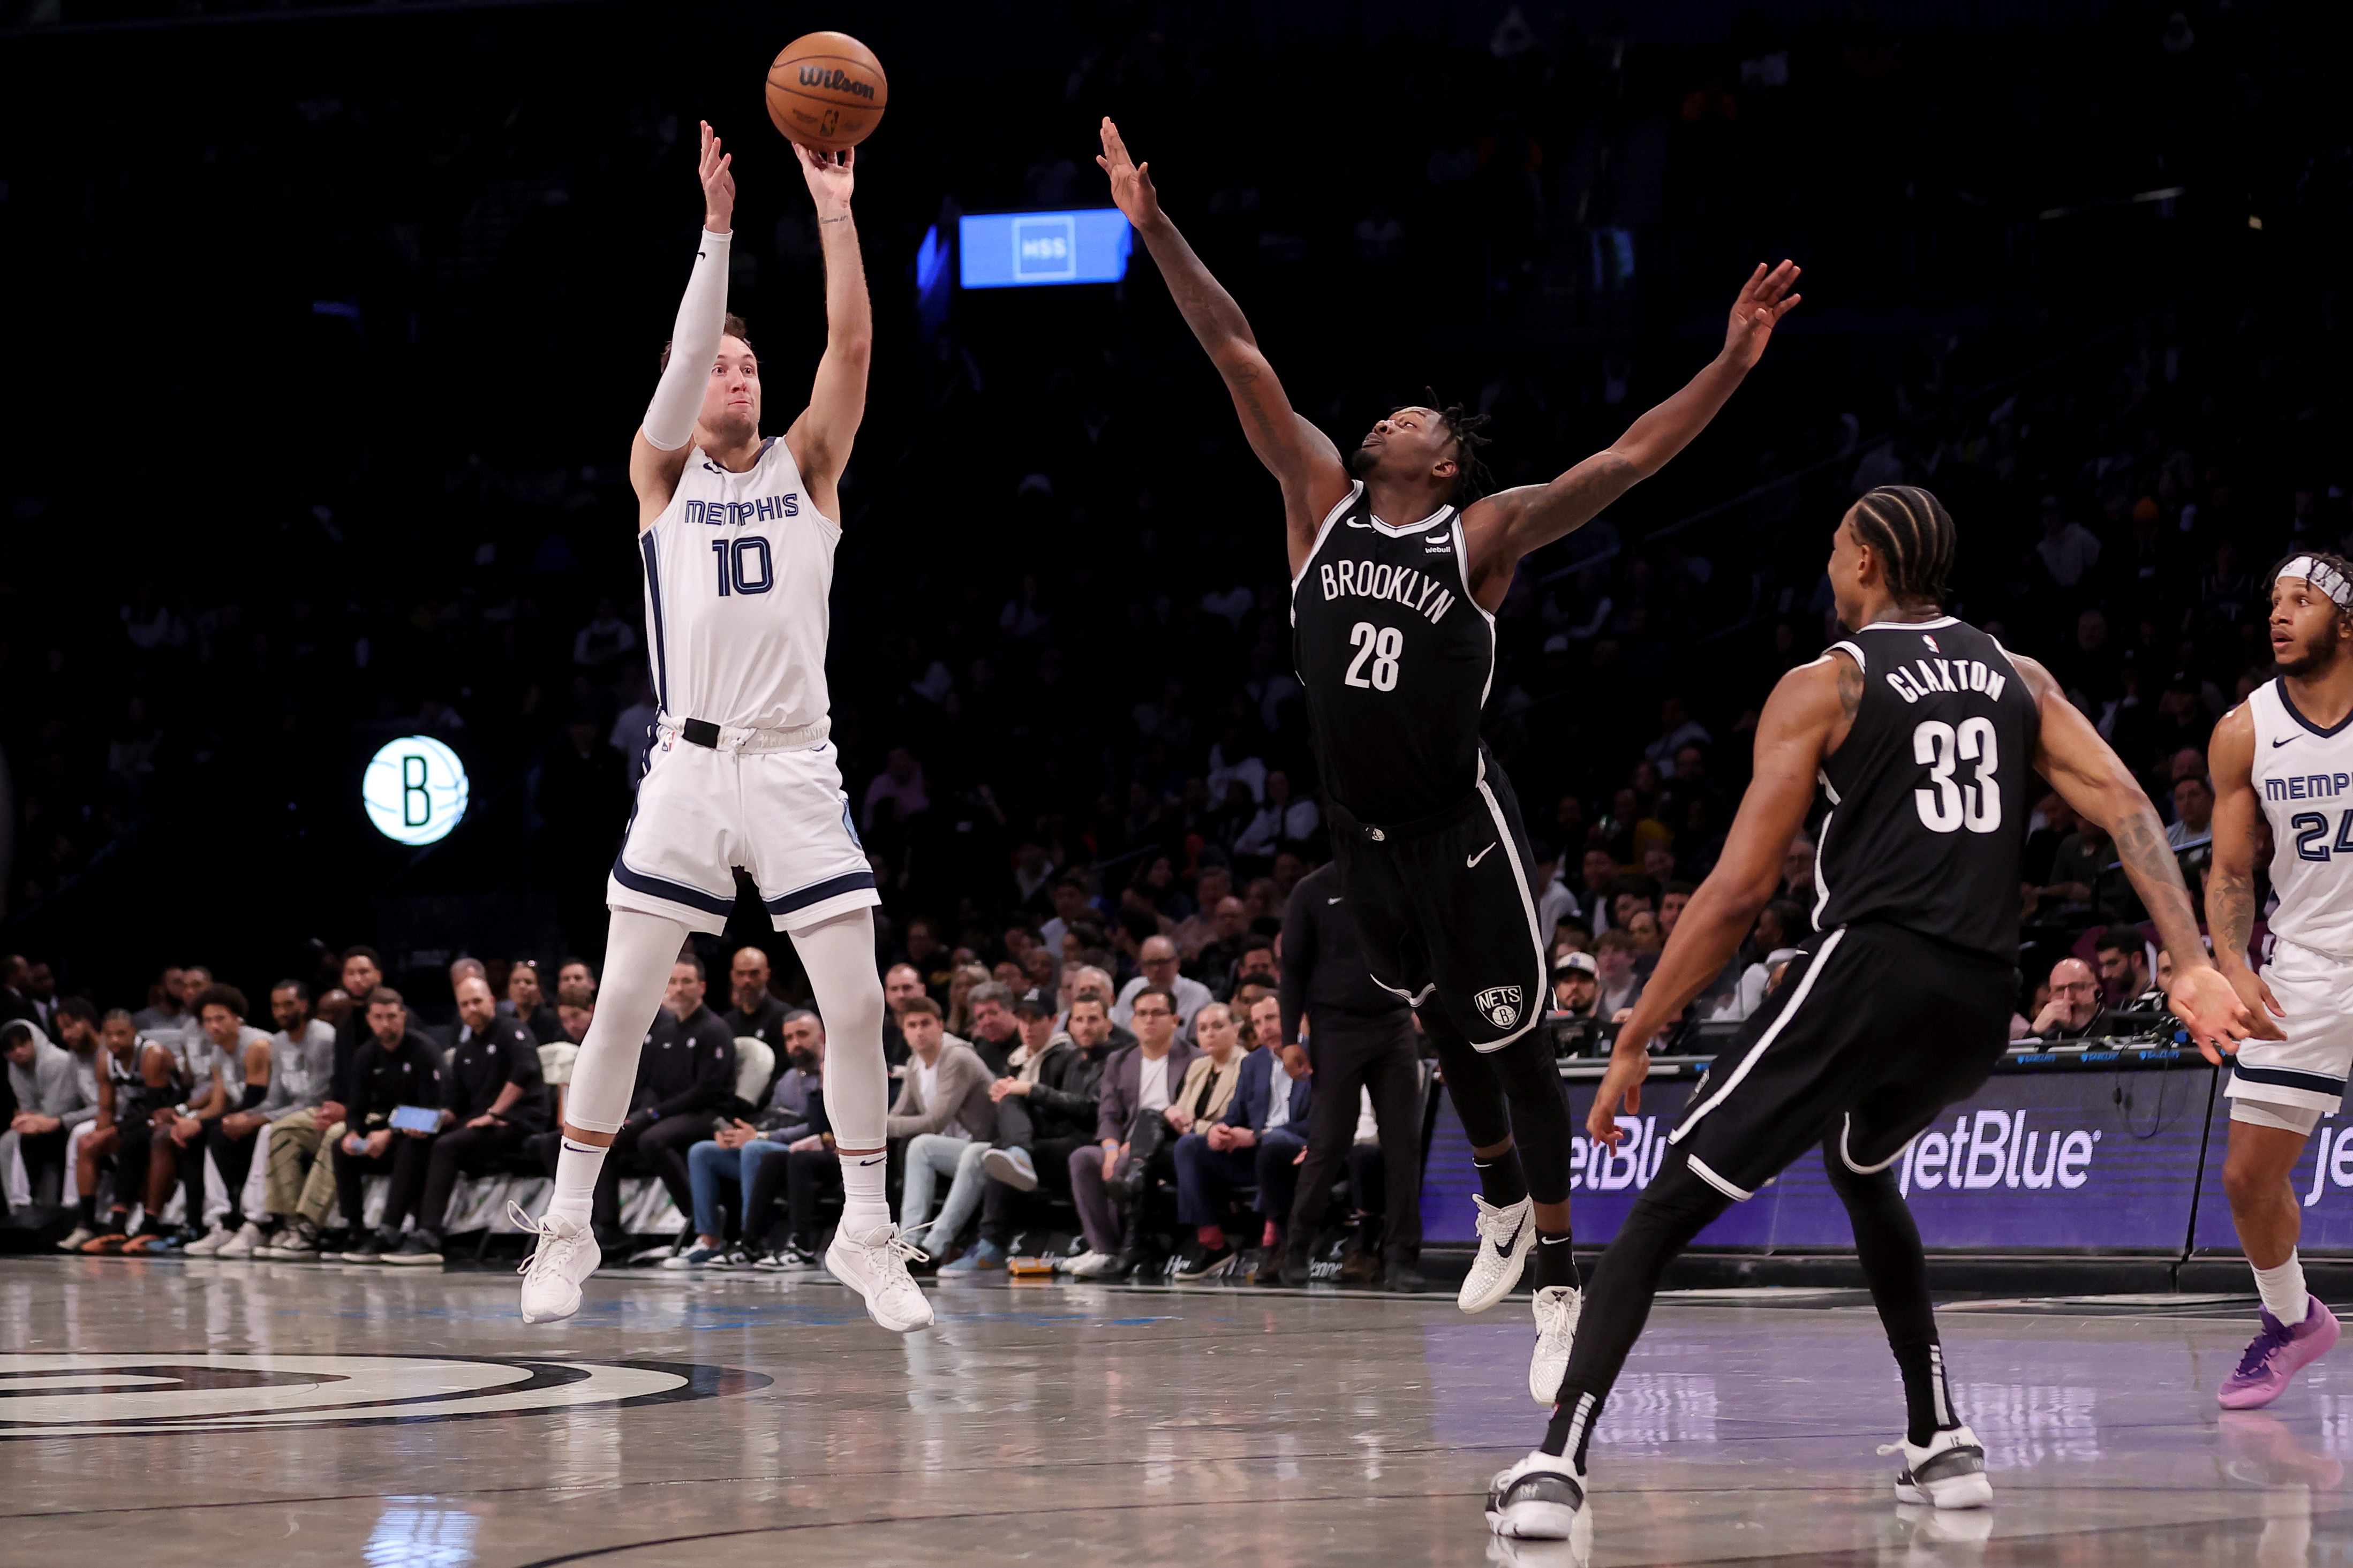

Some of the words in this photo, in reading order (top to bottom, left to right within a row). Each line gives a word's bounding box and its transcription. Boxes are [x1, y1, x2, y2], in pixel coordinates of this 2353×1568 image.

[800, 65, 874, 101] Wilson
[684, 493, 798, 526] MEMPHIS
[712, 536, 774, 596] 10
[1321, 560, 1455, 624] BROOKLYN
[1345, 622, 1403, 692] 28
[1885, 658, 2007, 703] CLAXTON
[404, 756, 430, 827] B
[1913, 716, 2002, 833] 33
[2265, 772, 2353, 801] MEMP
[1478, 988, 1520, 1012] NETS
[1499, 1009, 1510, 1024] B
